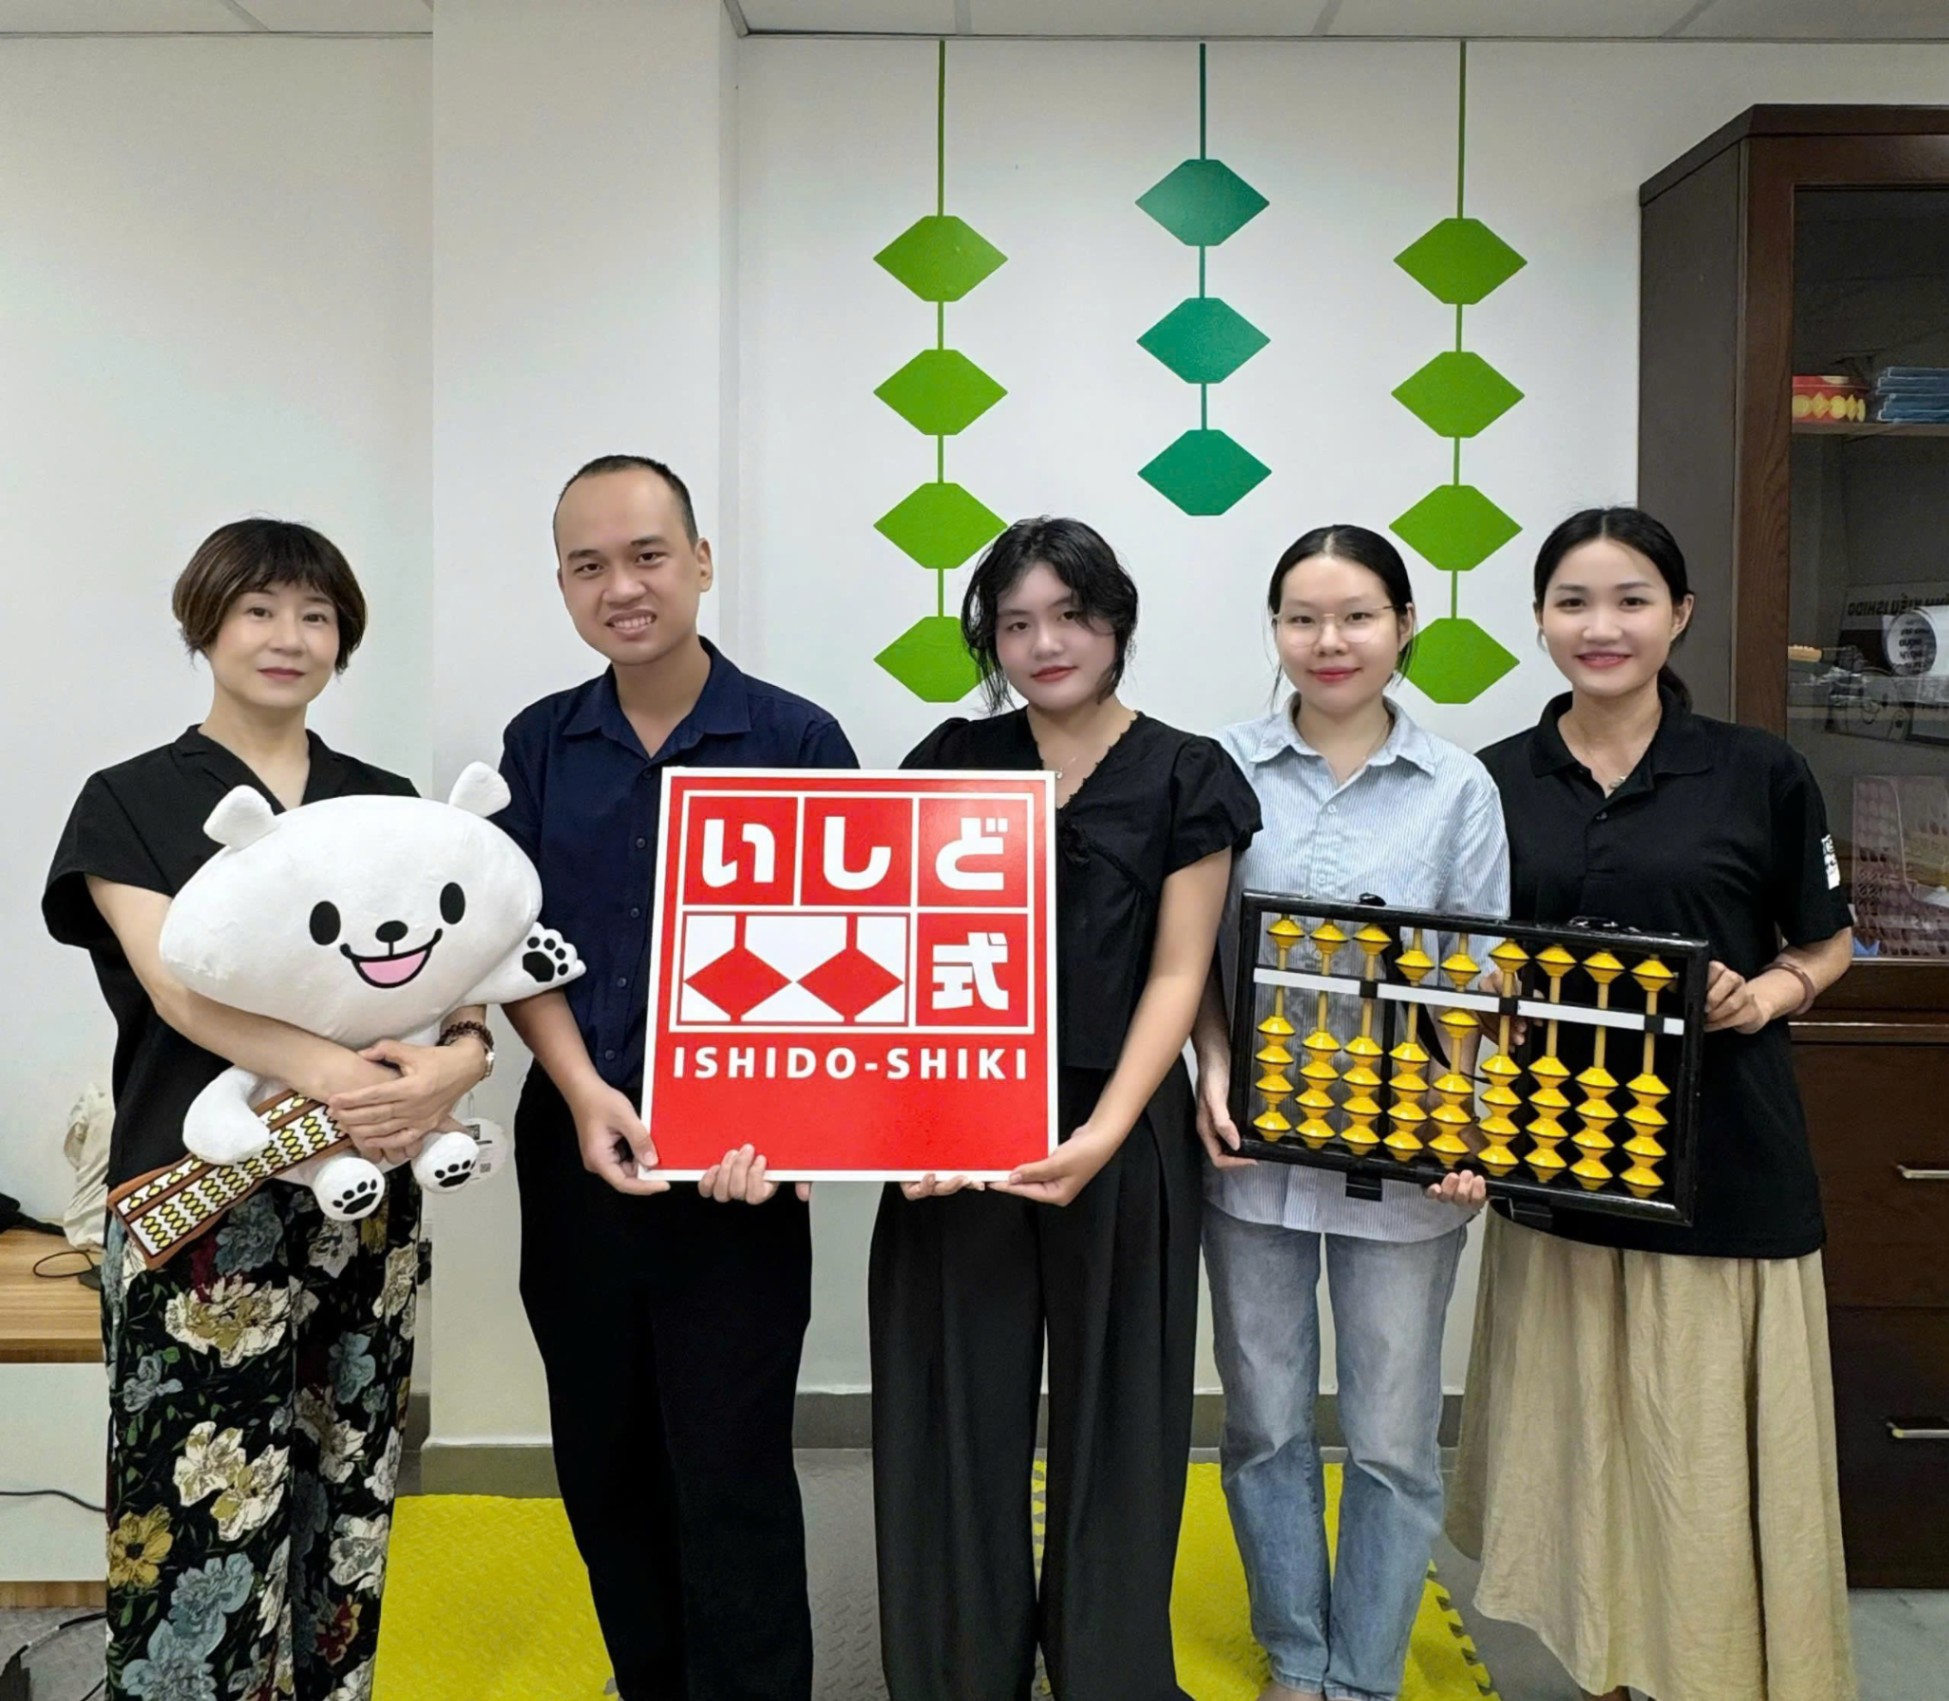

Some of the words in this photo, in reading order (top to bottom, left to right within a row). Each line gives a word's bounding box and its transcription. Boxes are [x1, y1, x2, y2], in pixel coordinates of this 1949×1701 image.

[702, 816, 1009, 891] いしど
[932, 931, 1009, 1011] 式
[673, 1046, 1027, 1080] ISHIDO-SHIKI
